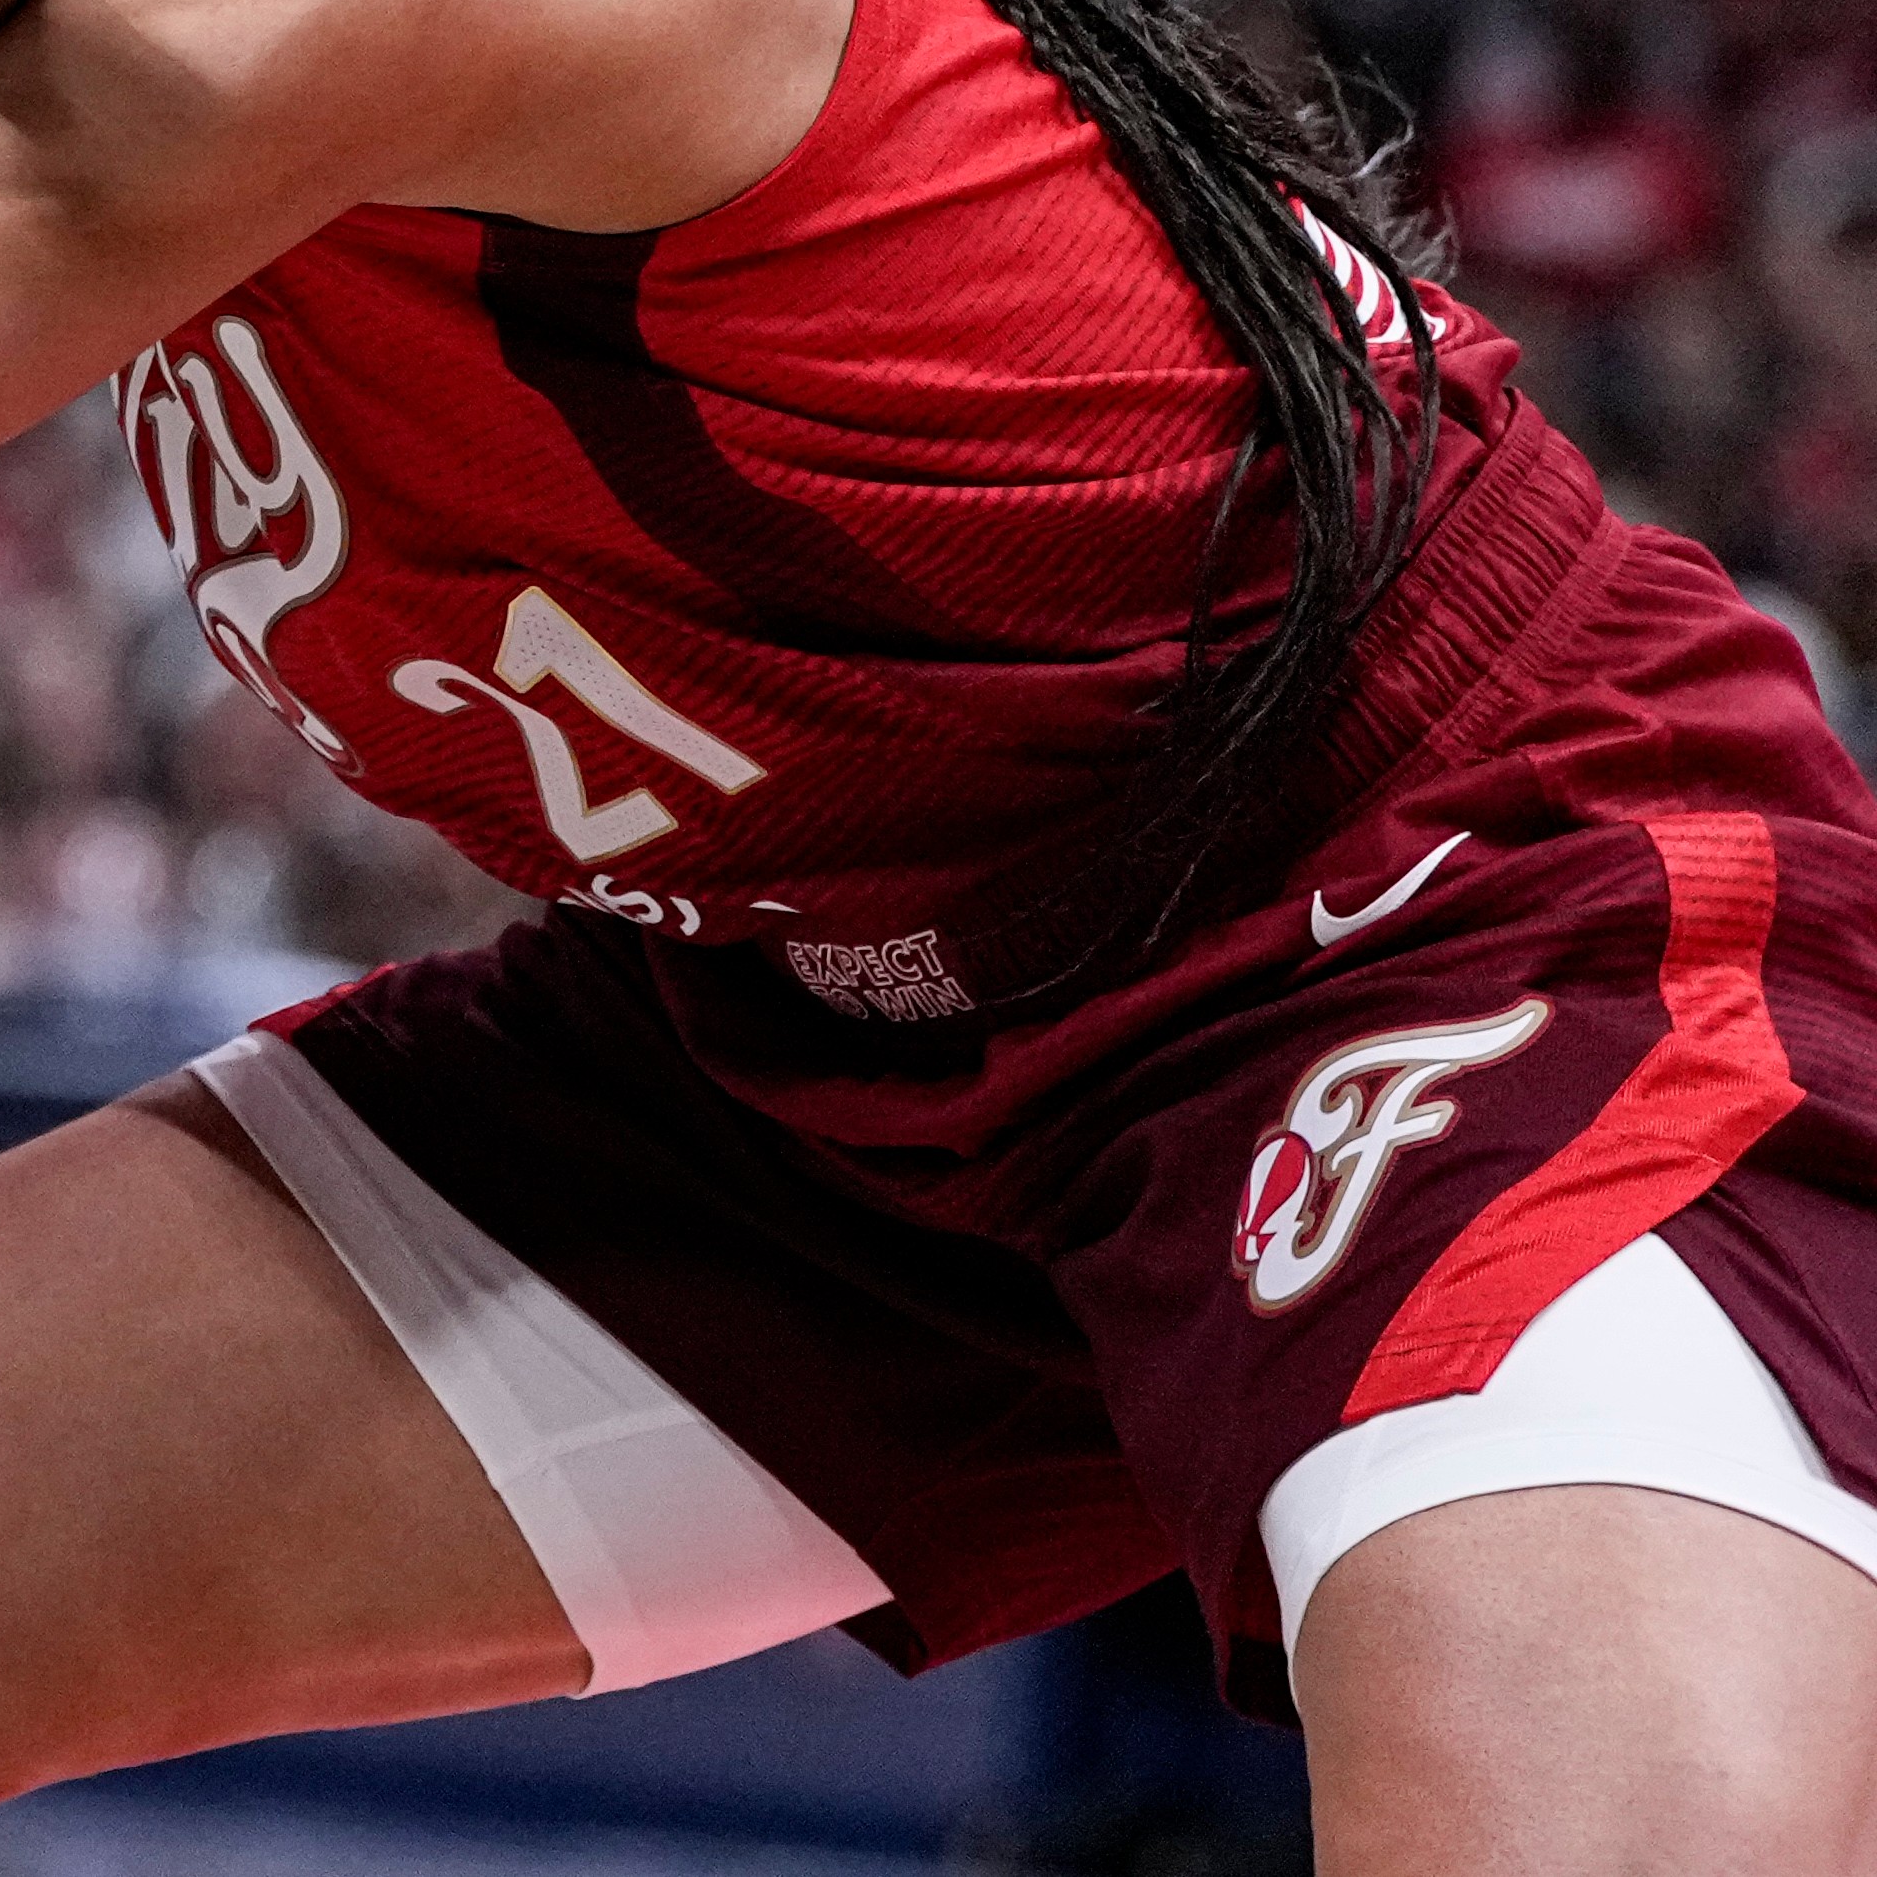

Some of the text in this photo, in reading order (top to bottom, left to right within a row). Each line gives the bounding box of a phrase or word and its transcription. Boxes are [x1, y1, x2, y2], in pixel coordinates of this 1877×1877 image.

[388, 585, 770, 867] 21
[786, 929, 944, 988] EXPECT
[864, 976, 977, 1022] WIN
